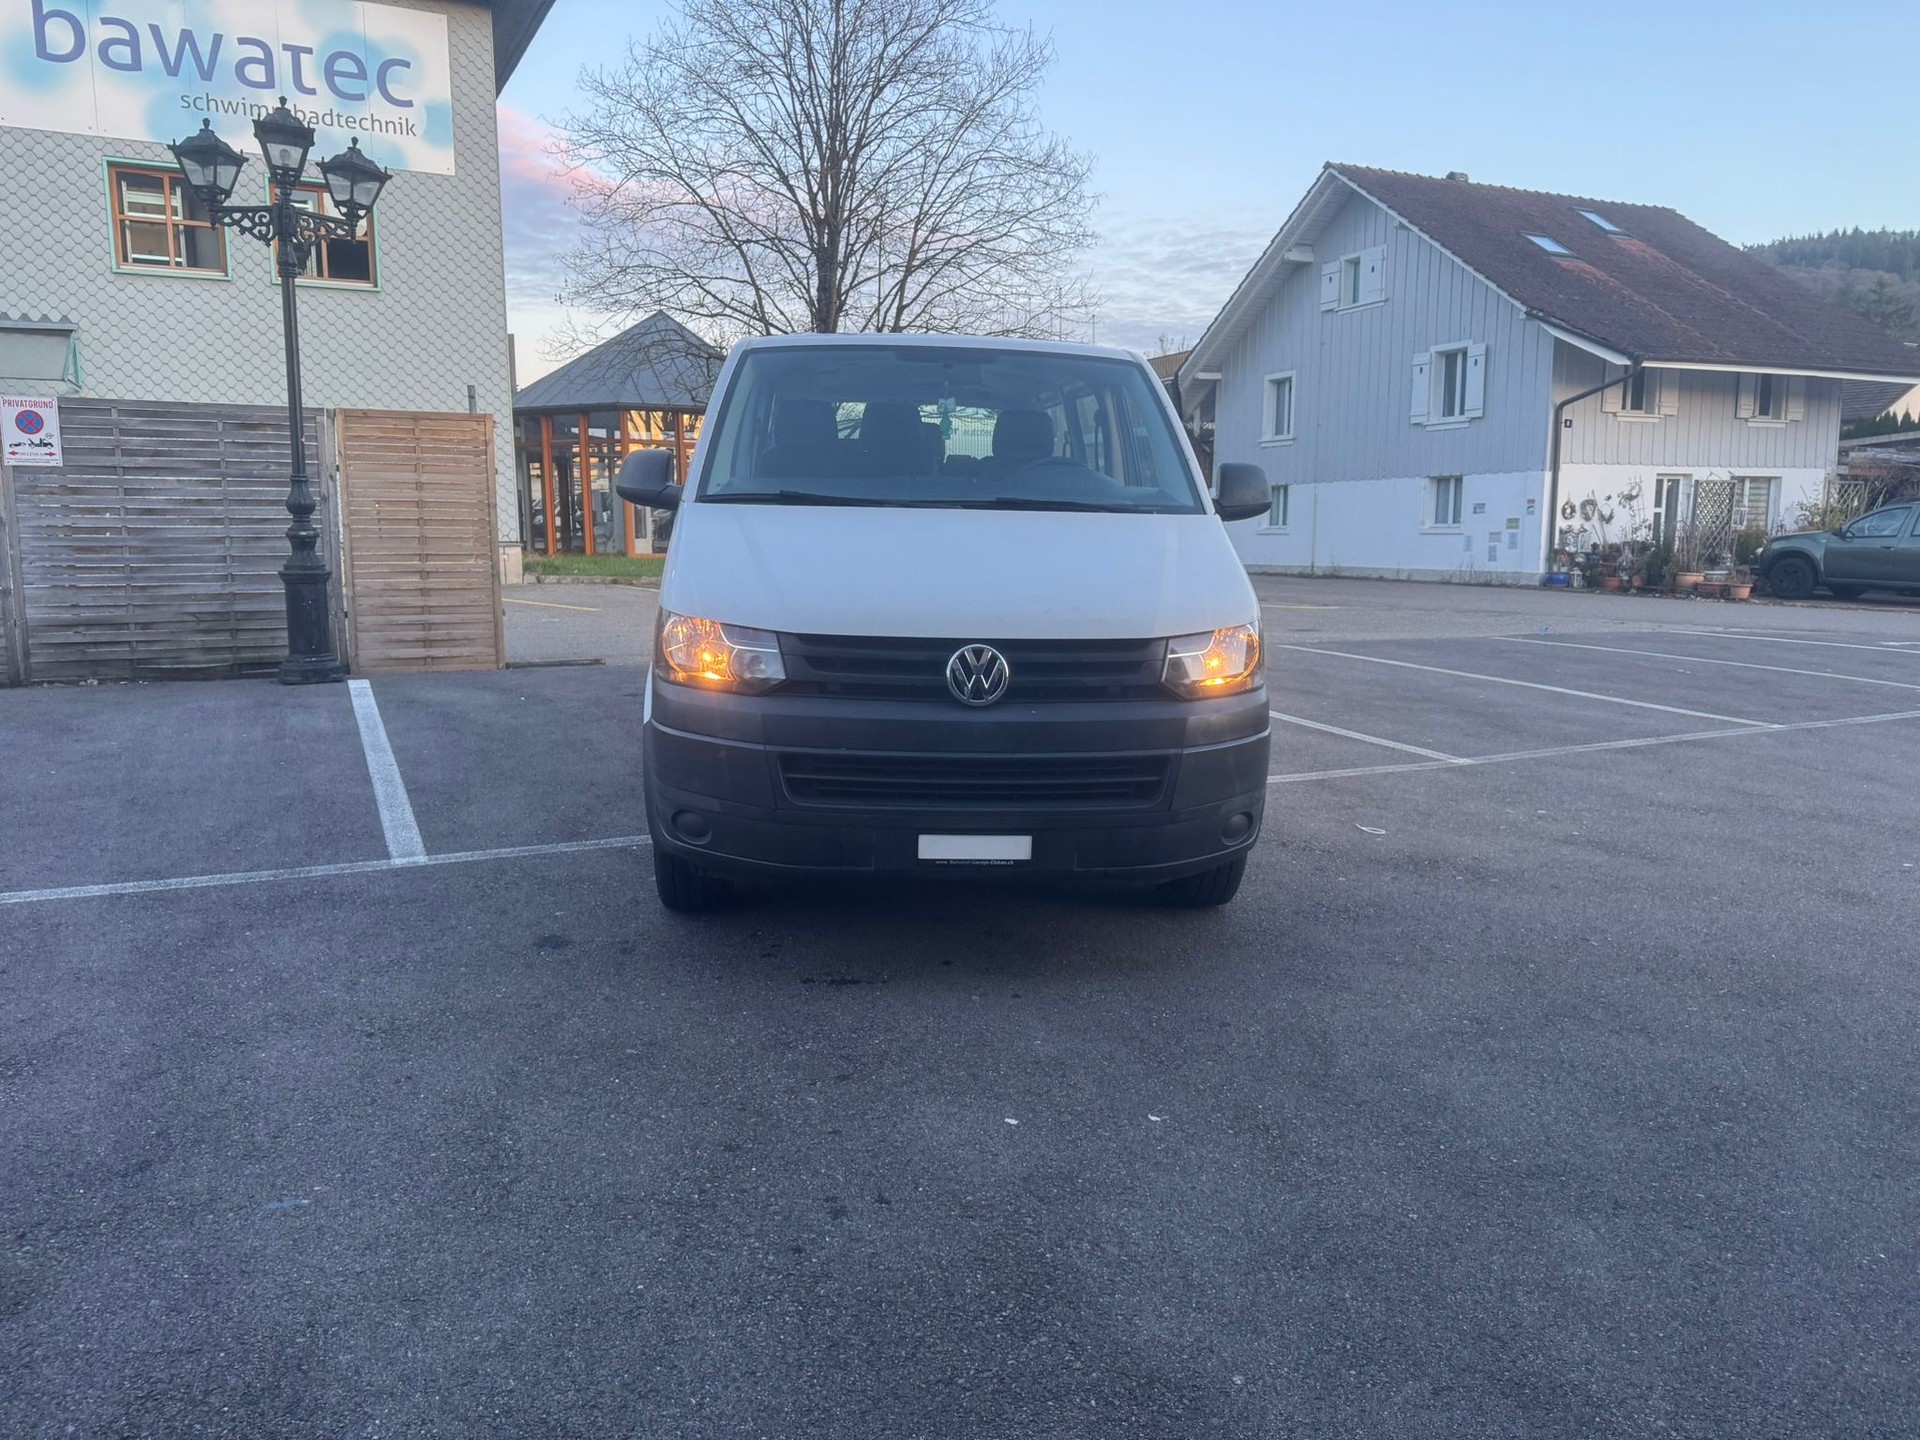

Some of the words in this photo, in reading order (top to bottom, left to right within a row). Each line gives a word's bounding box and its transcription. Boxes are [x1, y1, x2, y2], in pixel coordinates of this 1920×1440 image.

[31, 0, 415, 108] bawatec
[180, 92, 417, 137] schwimbadtechnik
[2, 399, 54, 409] PRIVATGRUND
